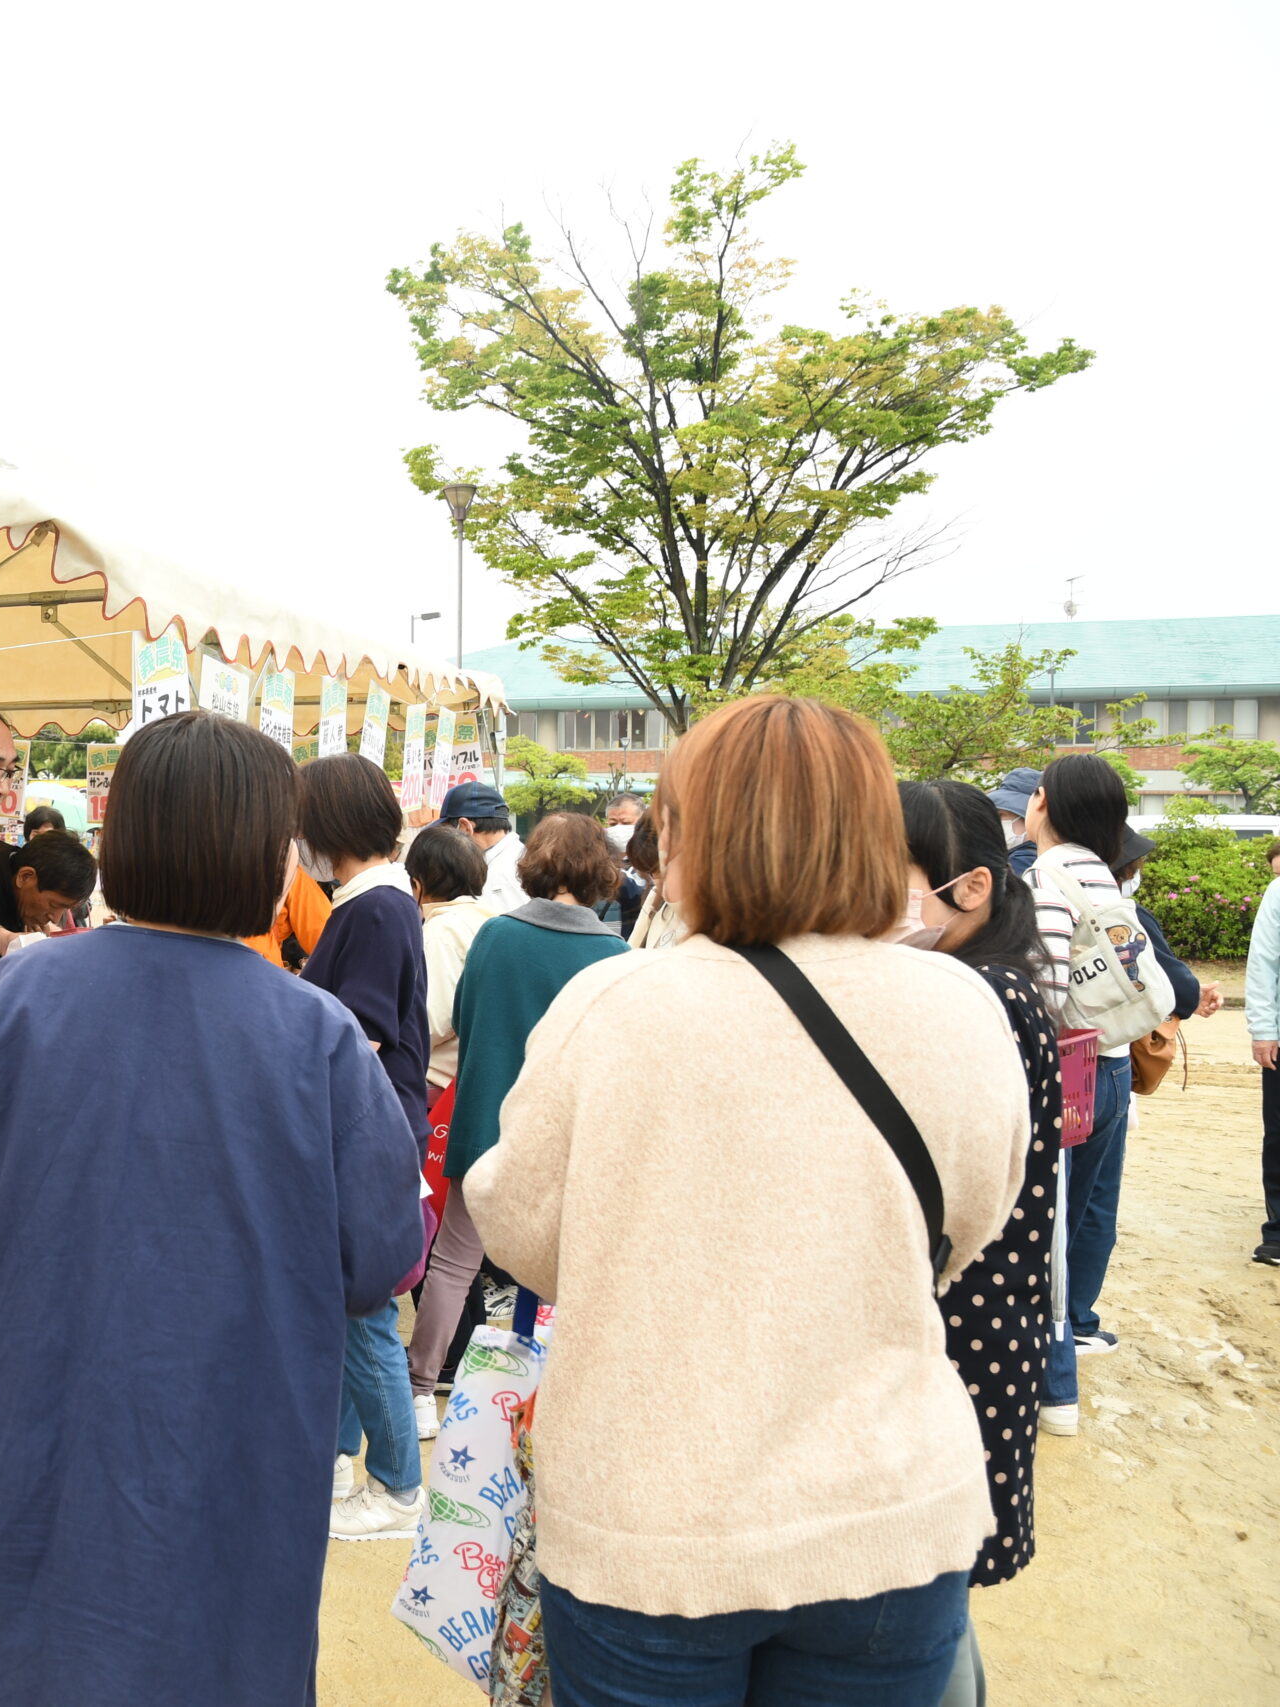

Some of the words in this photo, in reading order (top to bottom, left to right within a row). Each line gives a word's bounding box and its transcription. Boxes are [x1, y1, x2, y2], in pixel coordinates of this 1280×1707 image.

[138, 635, 185, 680] 義農祭
[141, 690, 185, 723] トマト
[89, 777, 111, 788] サンふ
[90, 795, 108, 820] 15
[1069, 958, 1108, 985] OLO
